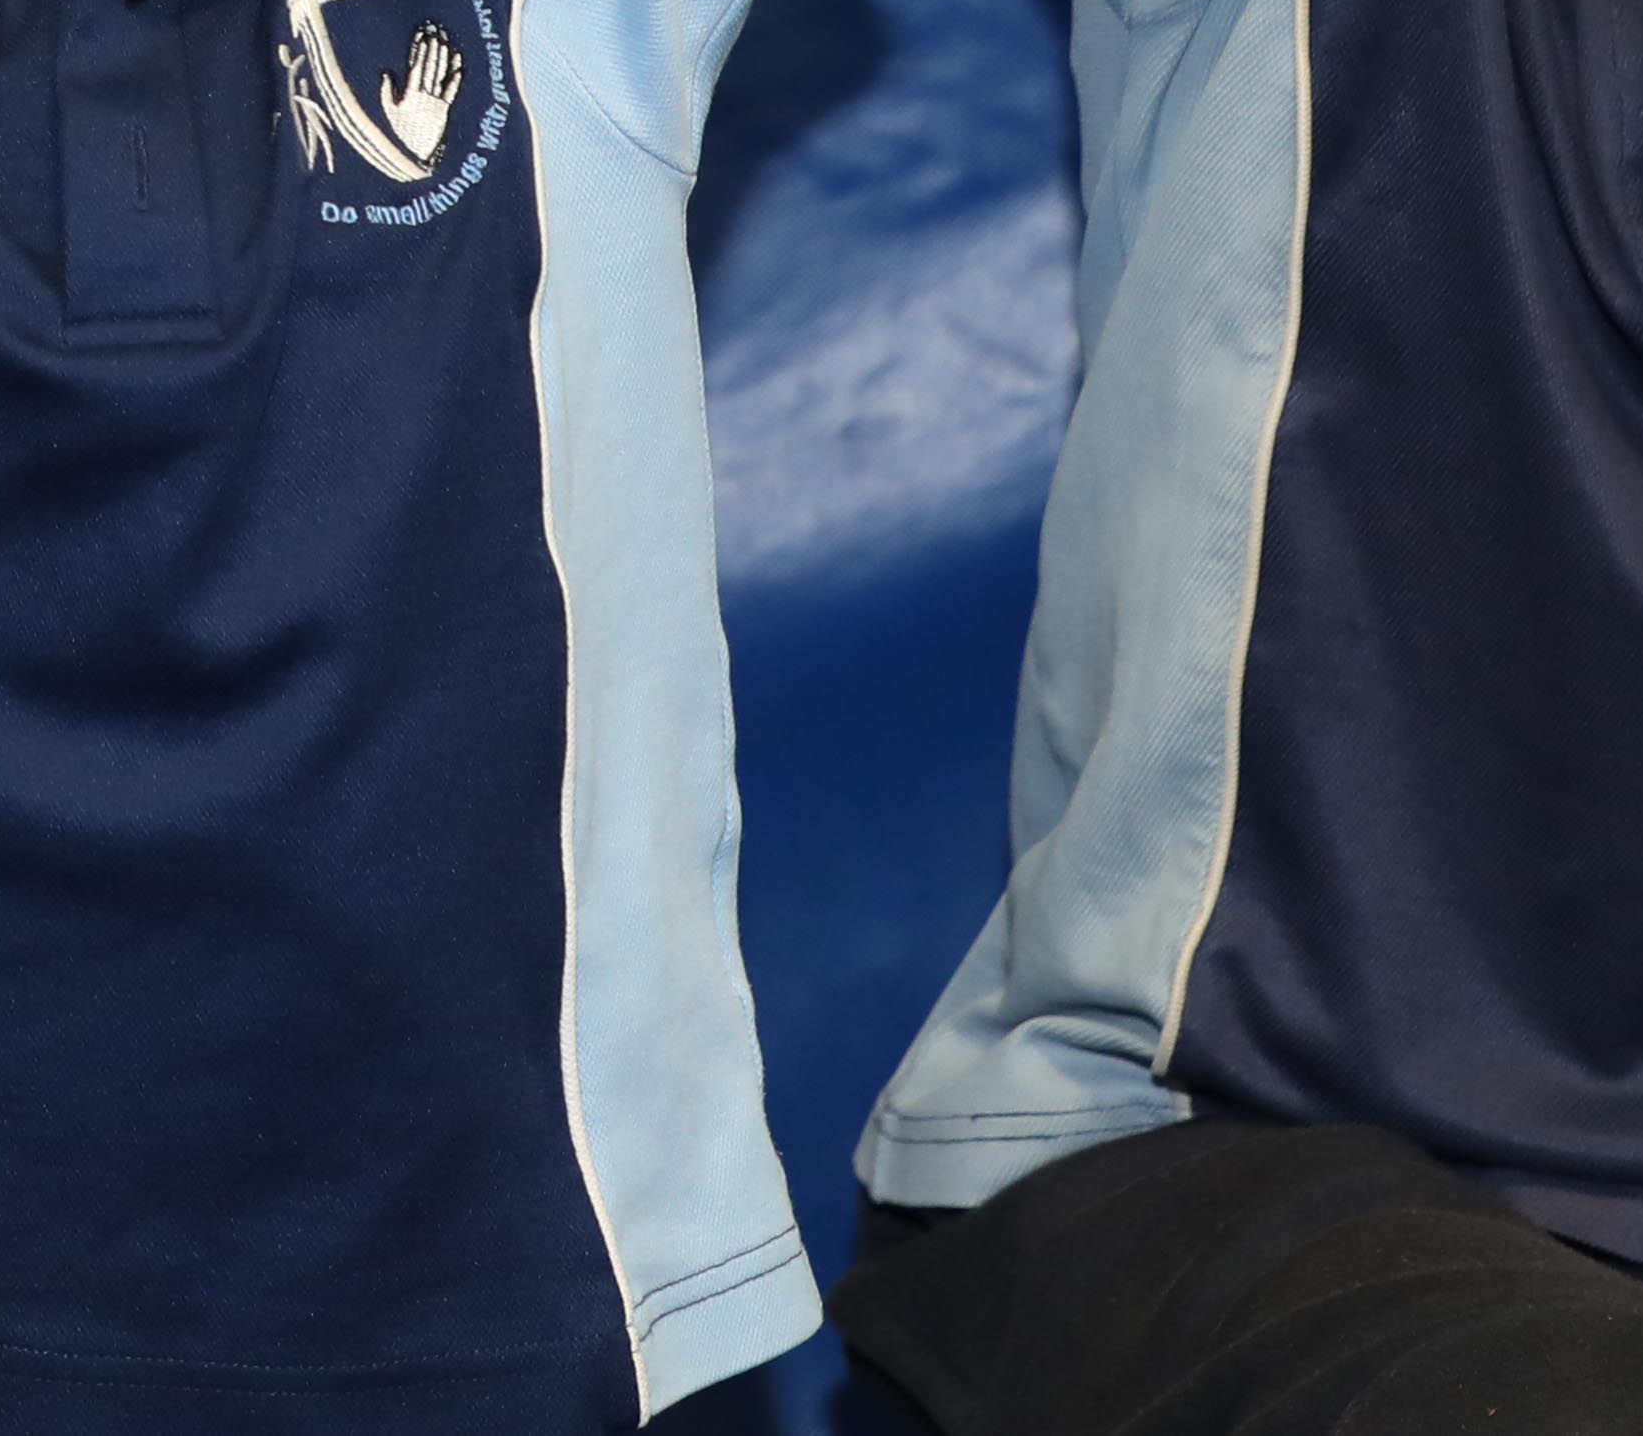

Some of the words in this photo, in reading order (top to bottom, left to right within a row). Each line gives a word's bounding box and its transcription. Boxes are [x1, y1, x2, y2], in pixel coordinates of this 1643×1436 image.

[321, 201, 358, 224] Do
[365, 196, 432, 226] small
[428, 152, 488, 215] things
[476, 102, 509, 151] with
